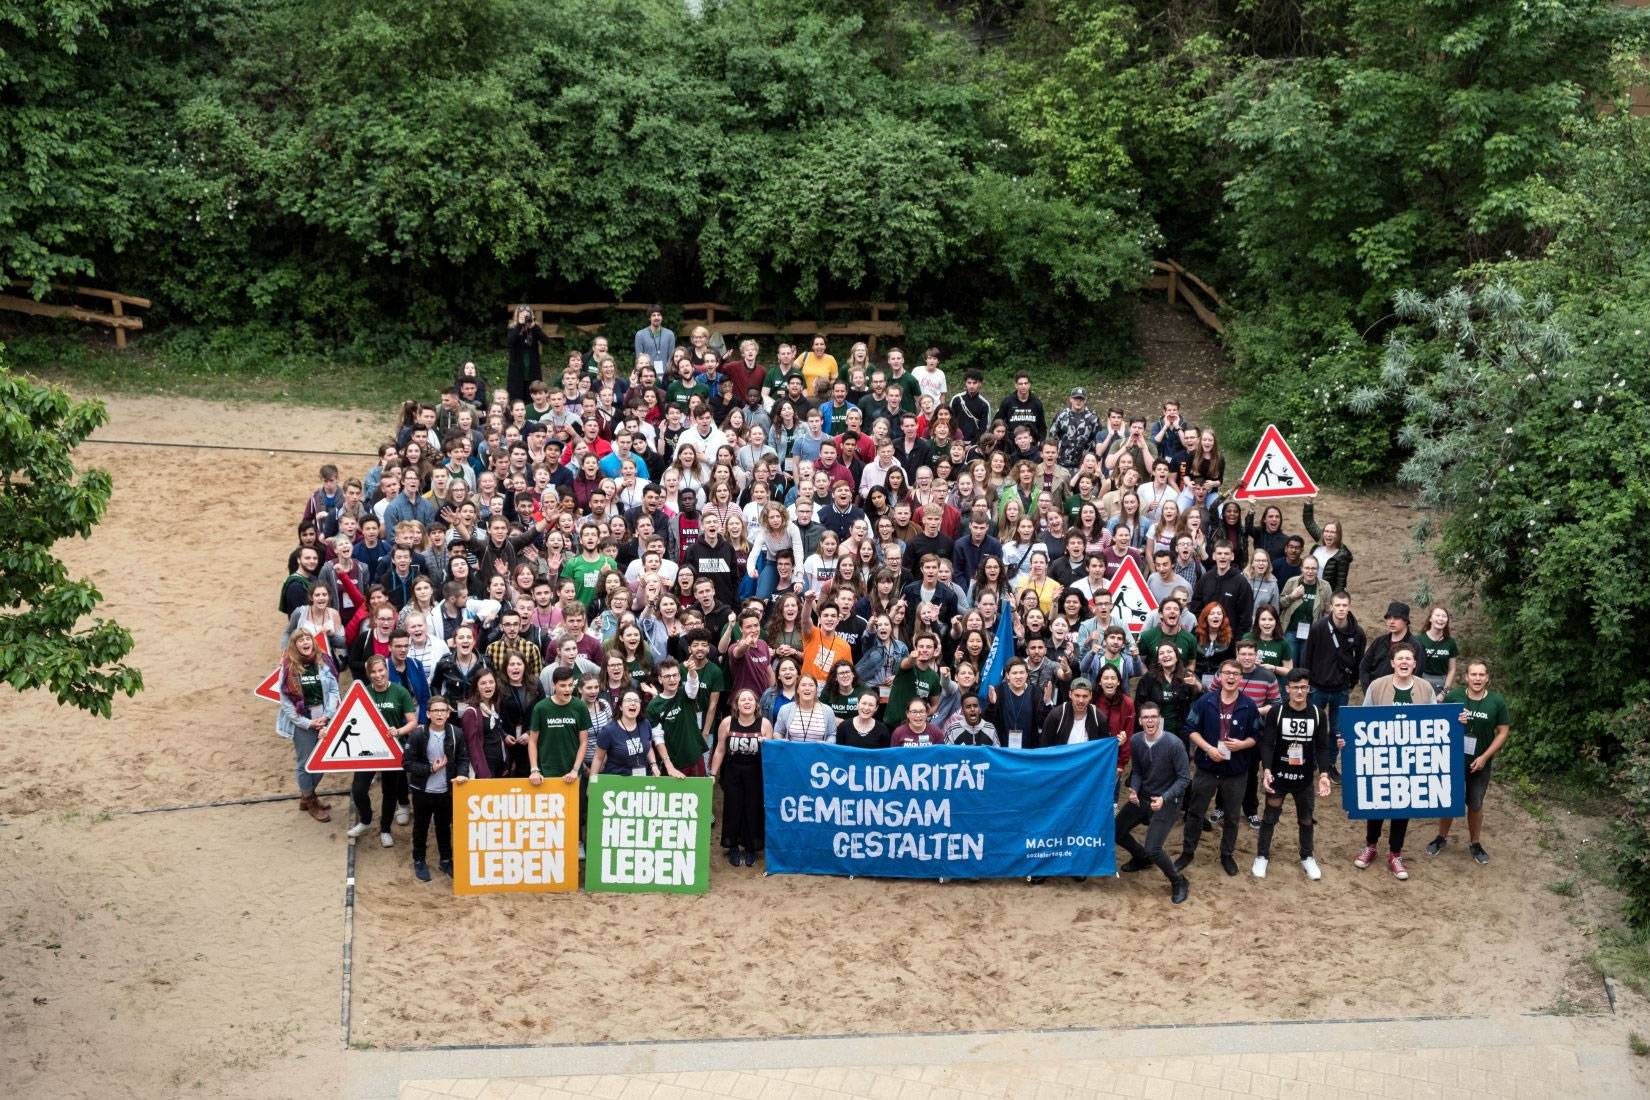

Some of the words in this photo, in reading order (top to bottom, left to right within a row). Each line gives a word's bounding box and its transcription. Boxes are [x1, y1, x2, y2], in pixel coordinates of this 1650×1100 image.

[729, 736, 759, 752] USA
[1353, 714, 1450, 746] SCHÜLER
[1355, 745, 1450, 775] HELFEN
[467, 787, 565, 820] SCHÜLER
[602, 785, 698, 818] SCHÜLER
[1356, 774, 1452, 810] LEBEN
[780, 795, 951, 828] GEMEINSAM
[468, 820, 565, 850] HELFEN
[601, 817, 697, 849] HELFEN
[832, 831, 985, 861] GESTALTEN
[1025, 837, 1063, 849] MACH
[1067, 836, 1106, 848] DOCH.
[469, 850, 565, 886] LEBEN
[600, 848, 696, 886] LEBEN
